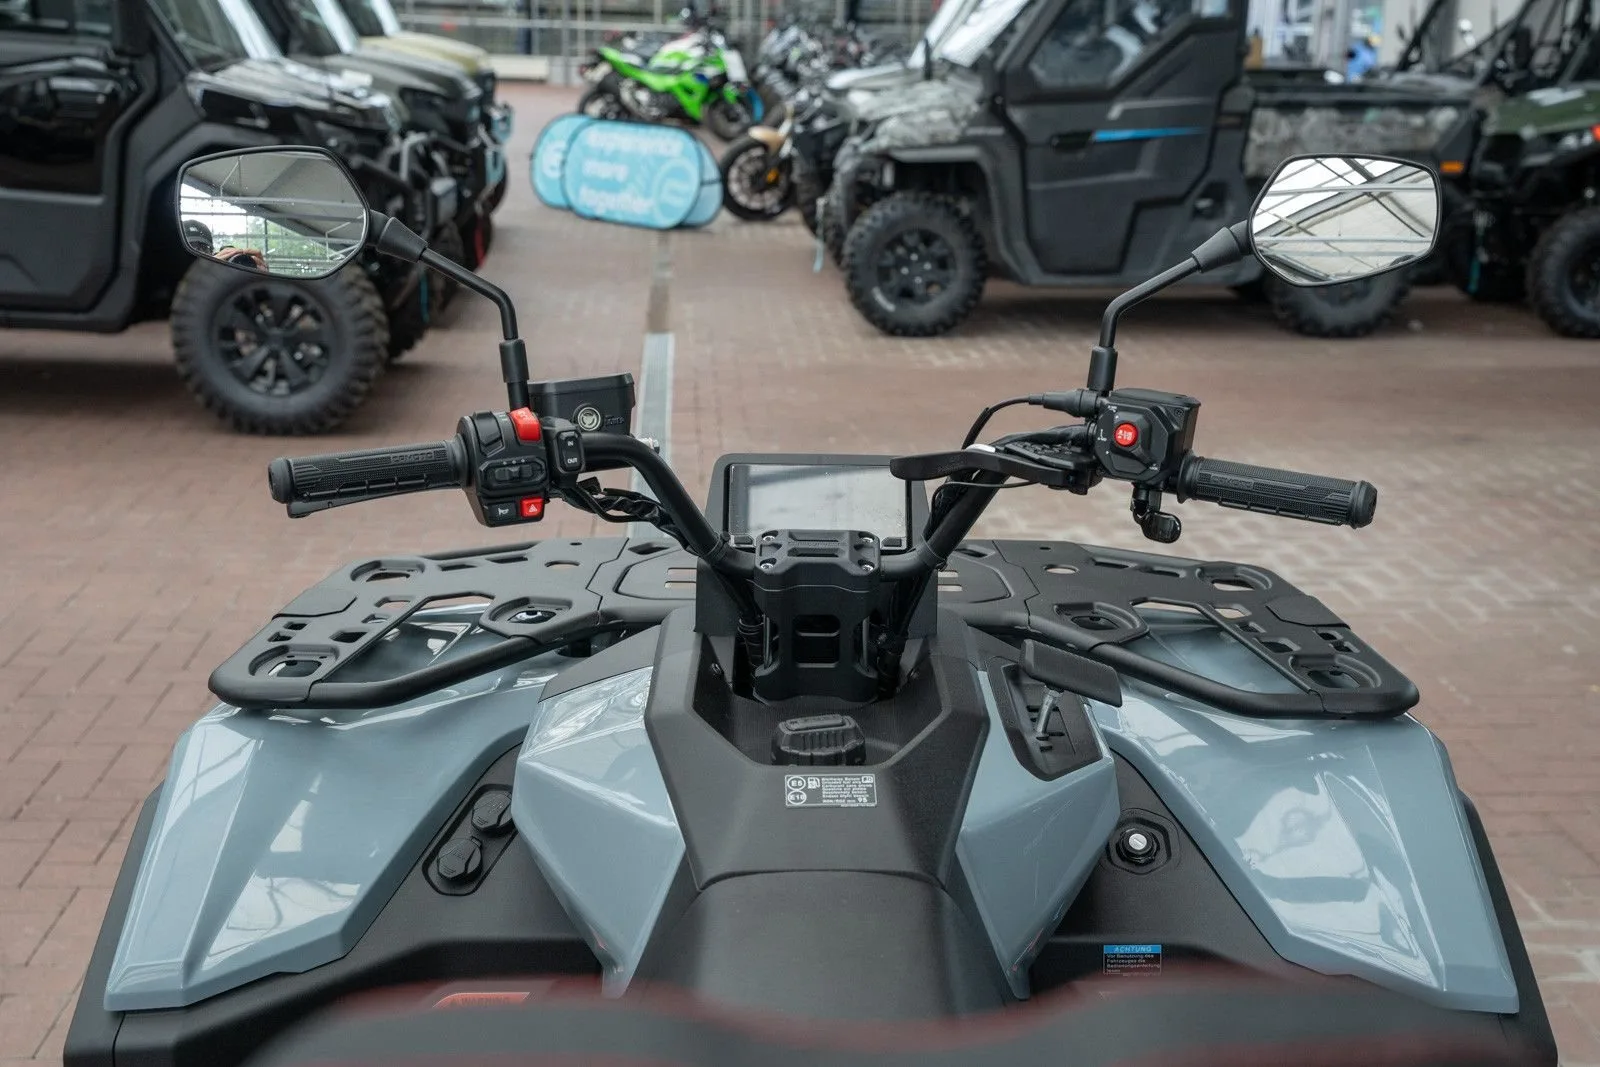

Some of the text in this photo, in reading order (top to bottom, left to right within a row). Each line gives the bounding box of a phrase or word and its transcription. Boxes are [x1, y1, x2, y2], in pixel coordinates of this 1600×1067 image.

[587, 128, 683, 156] experience
[582, 159, 629, 182] more
[579, 184, 654, 216] together
